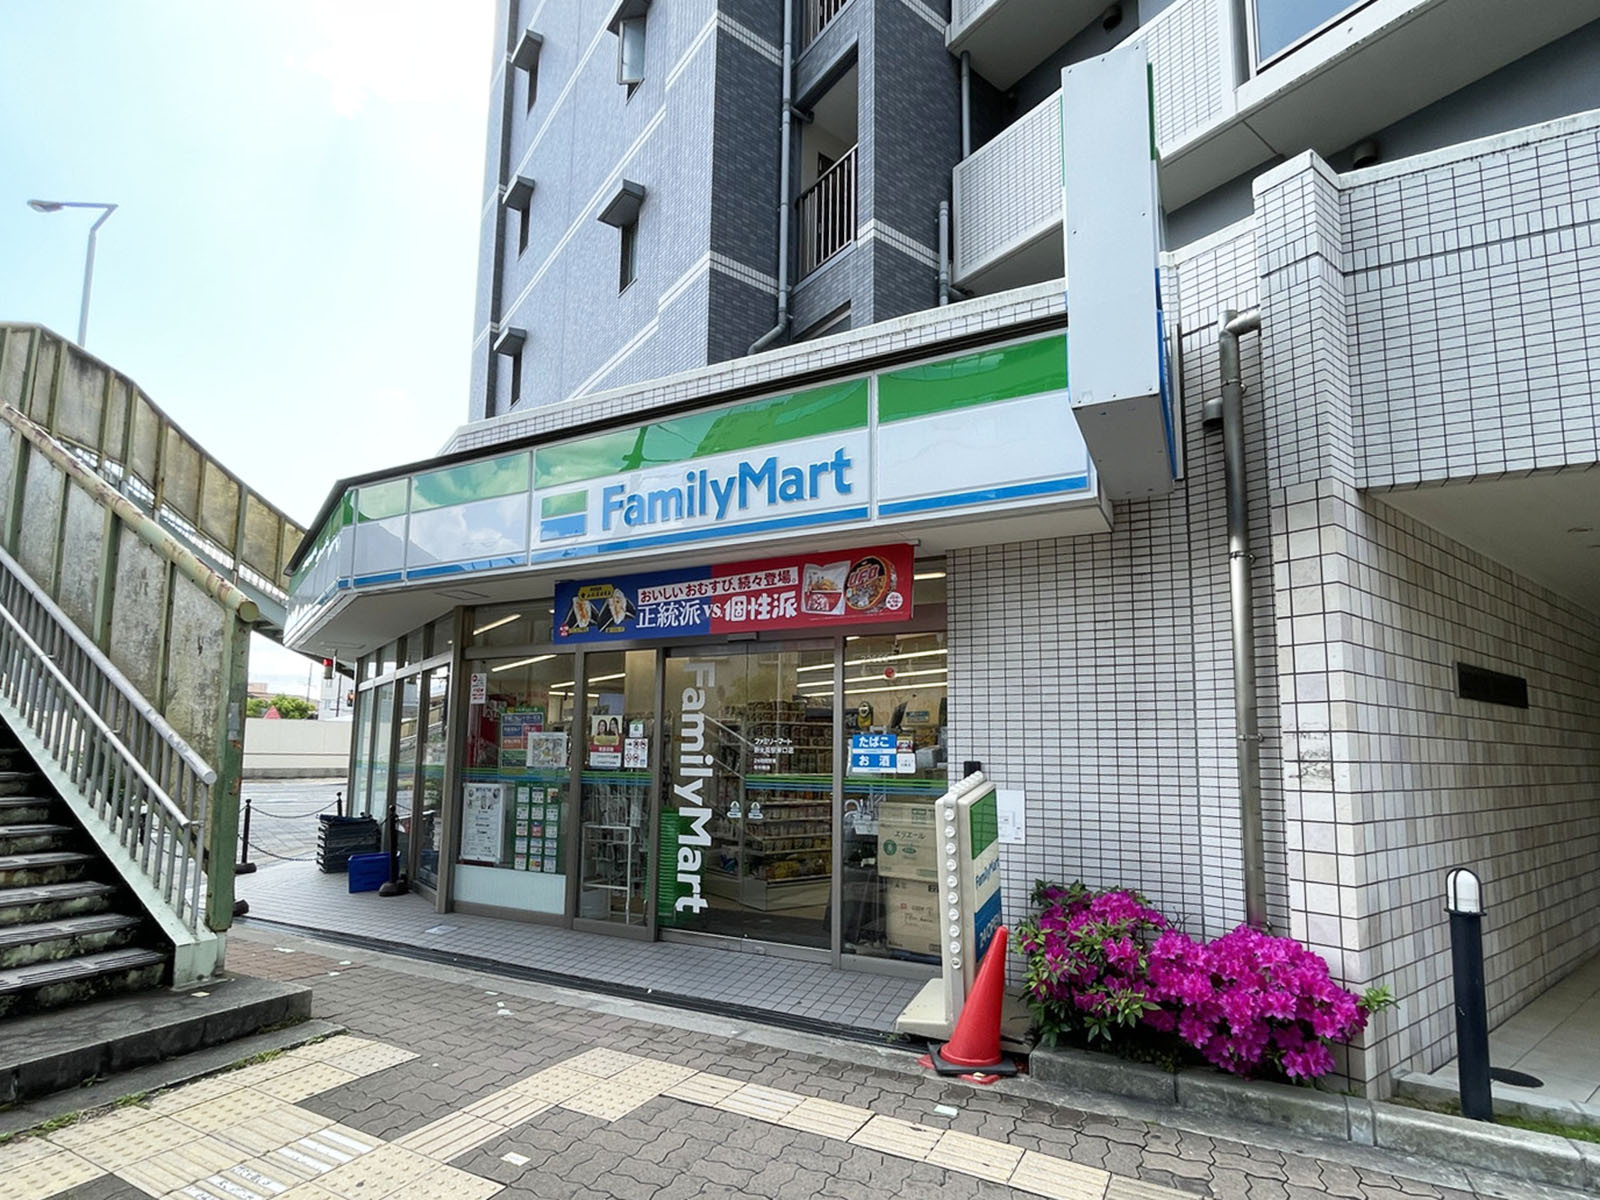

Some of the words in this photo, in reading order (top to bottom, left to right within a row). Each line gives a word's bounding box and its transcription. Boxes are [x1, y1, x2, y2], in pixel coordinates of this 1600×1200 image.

[602, 447, 853, 531] FamilyMart
[858, 736, 890, 748] たばこ
[674, 661, 717, 914] FamilyMart
[894, 830, 926, 840] エリエール
